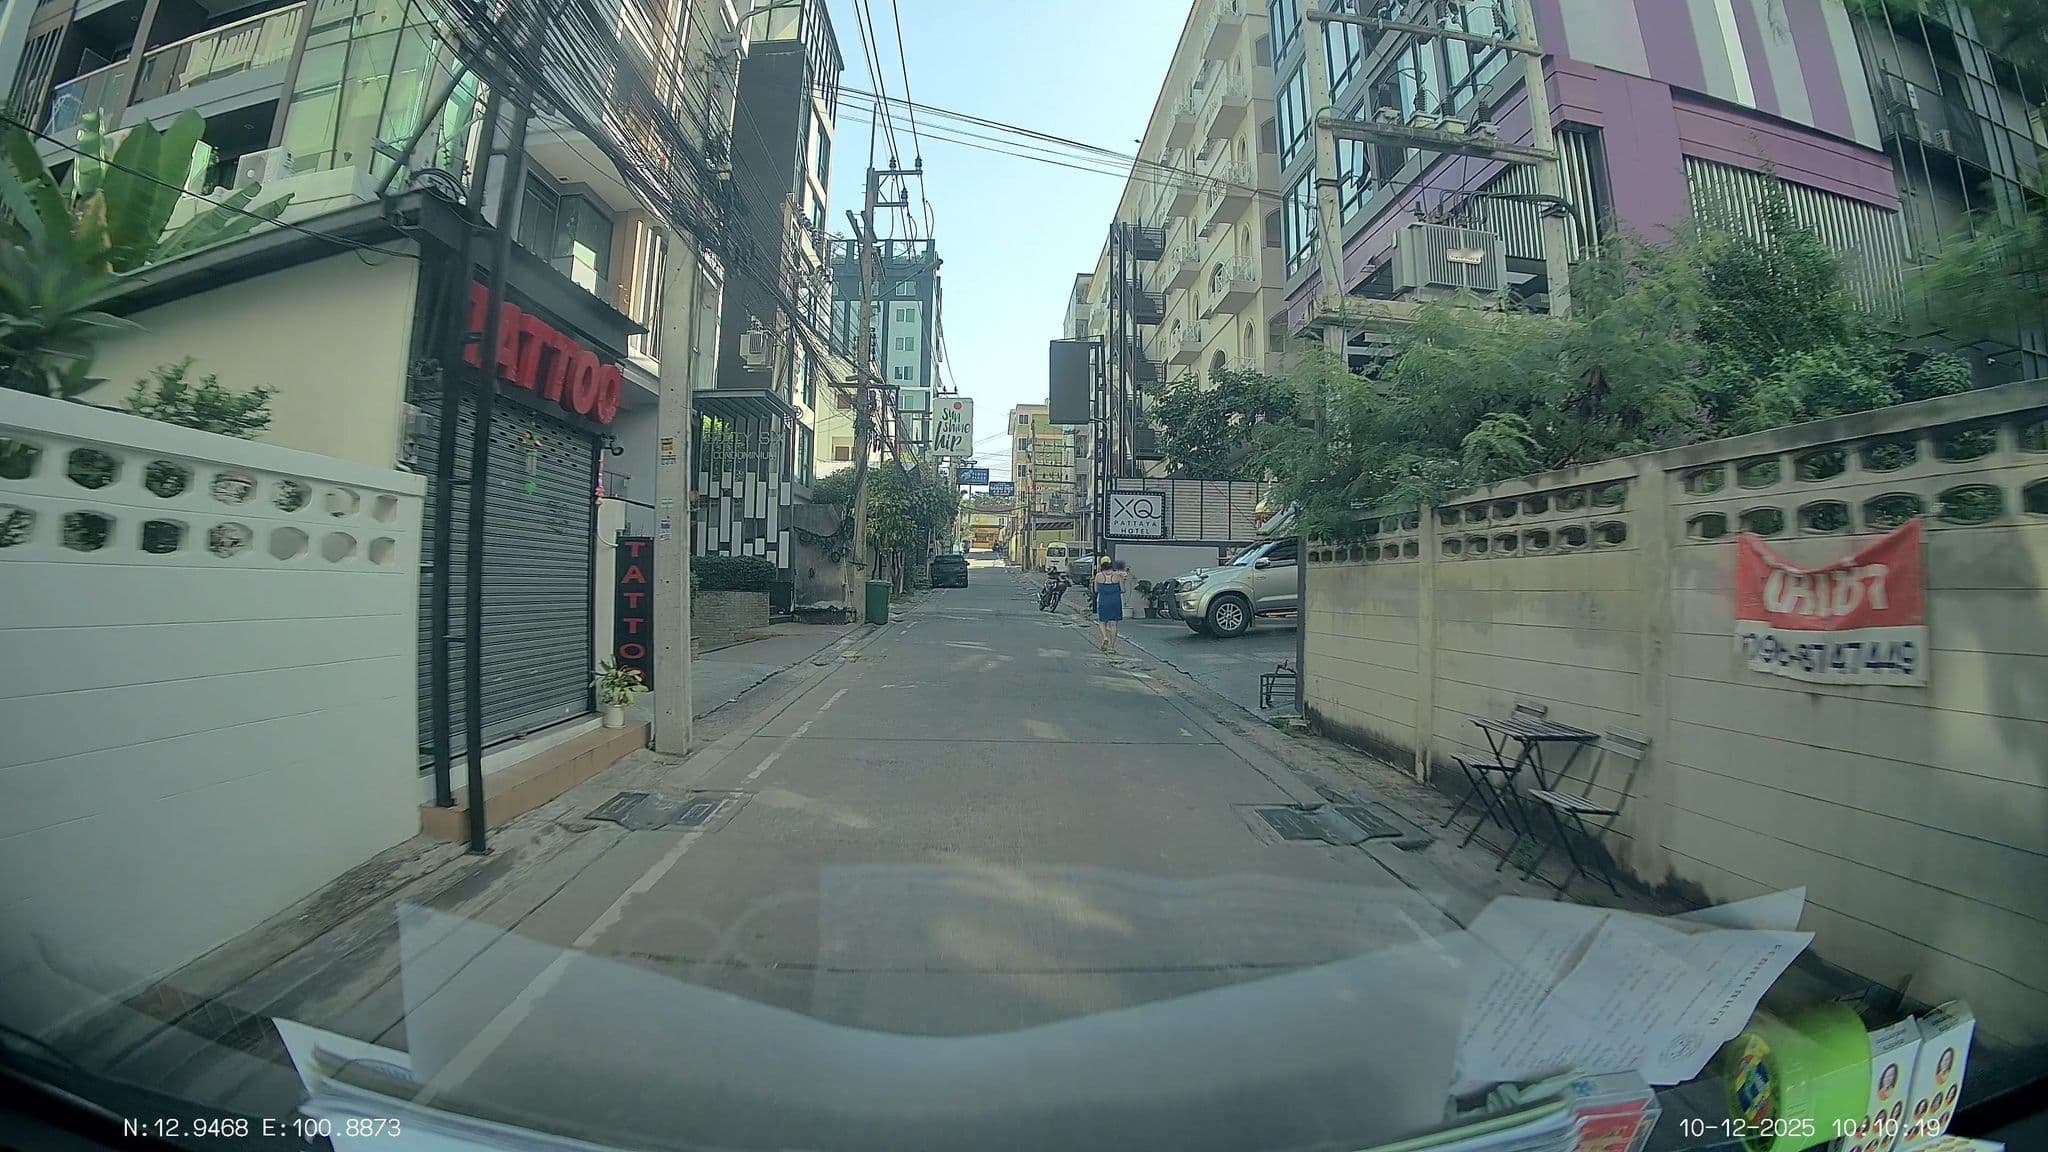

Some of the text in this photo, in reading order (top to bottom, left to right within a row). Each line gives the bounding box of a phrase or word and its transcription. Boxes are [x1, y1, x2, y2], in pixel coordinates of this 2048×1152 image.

[464, 279, 624, 424] TATTOO
[713, 451, 777, 461] CONDOMINIUM
[1113, 497, 1162, 519] XQ
